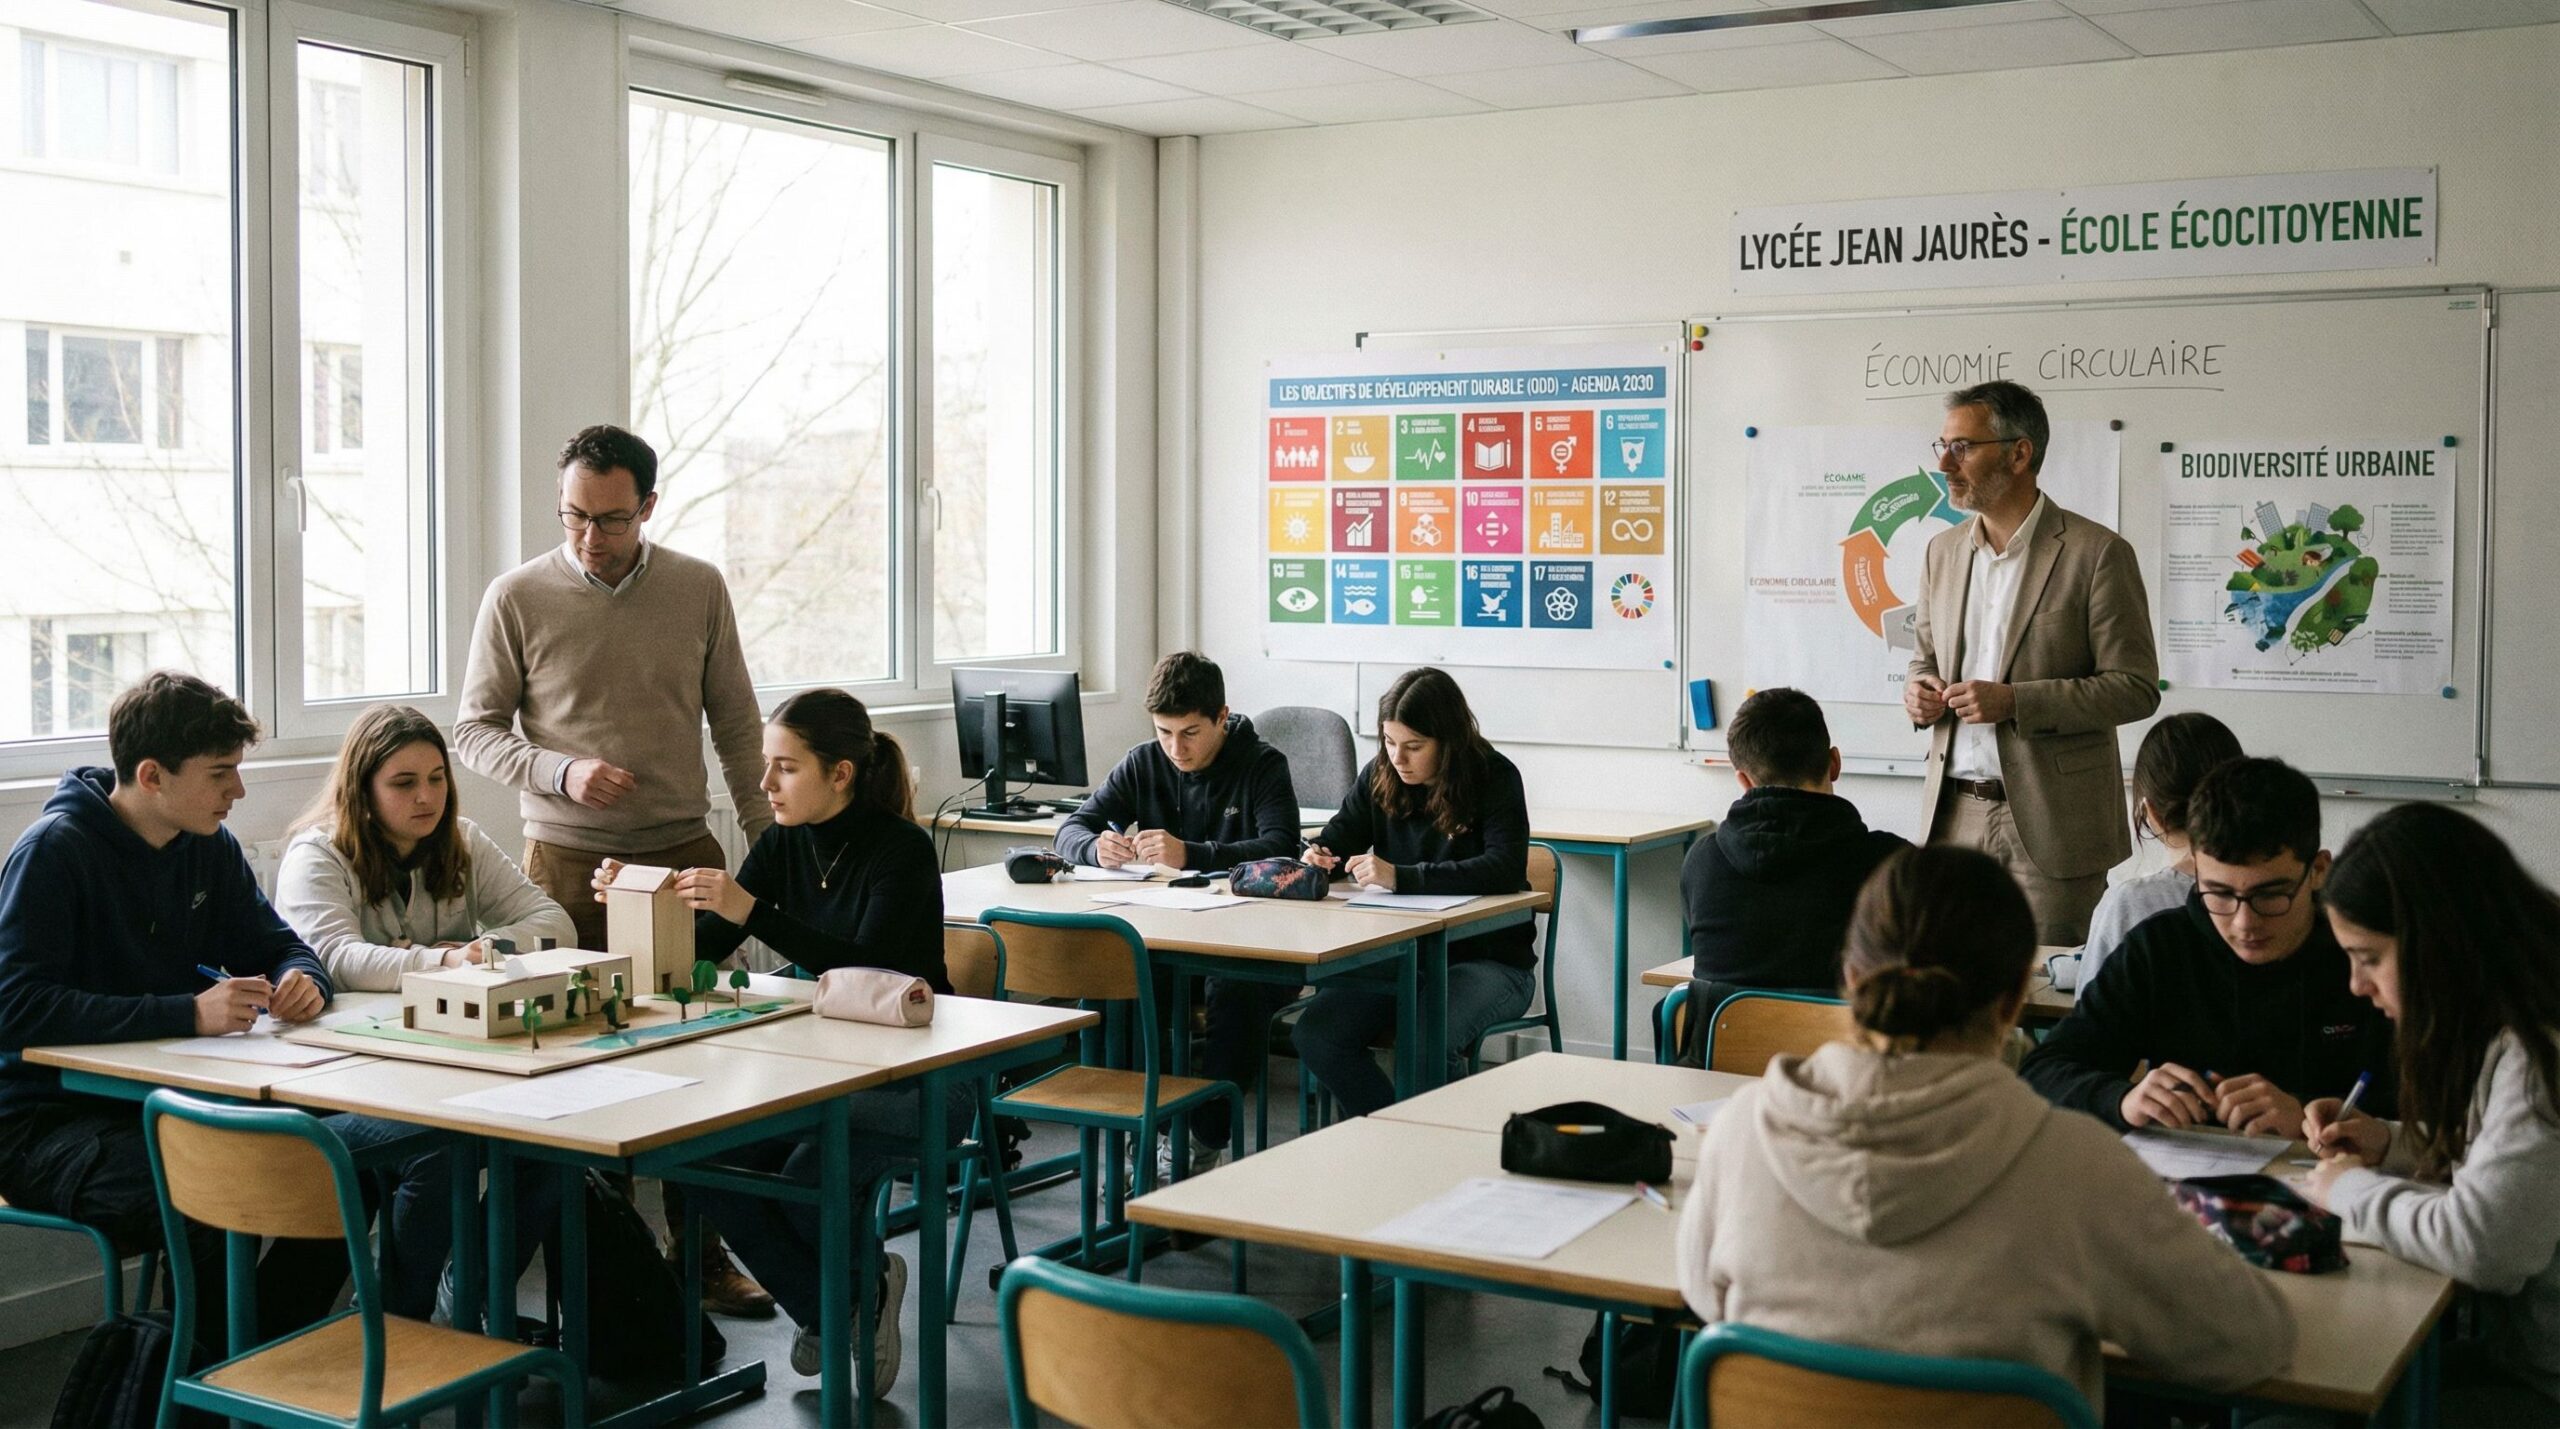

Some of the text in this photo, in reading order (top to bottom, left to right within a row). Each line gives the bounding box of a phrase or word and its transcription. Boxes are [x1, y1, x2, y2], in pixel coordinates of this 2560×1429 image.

[1739, 196, 2424, 271] LYCÉE JEAN JAURÈS - ÉCOLE ÉCOCITOYENNE
[1865, 339, 2227, 388] ÉCONOMIE CIRCULAIRE
[1279, 384, 1299, 402] LES
[1358, 381, 1373, 399] DE
[1471, 377, 1524, 396] DURABLE
[1571, 375, 1620, 394] AGENDA
[1622, 374, 1654, 393] 2030
[1336, 421, 1344, 436] 2
[1401, 419, 1409, 435] 3
[2180, 444, 2435, 479] BIODIVERSITÉ URBAINE
[1465, 490, 1478, 507] 10
[1604, 490, 1616, 506] 12
[1464, 564, 1478, 581] 16
[1534, 565, 1547, 581] 17
